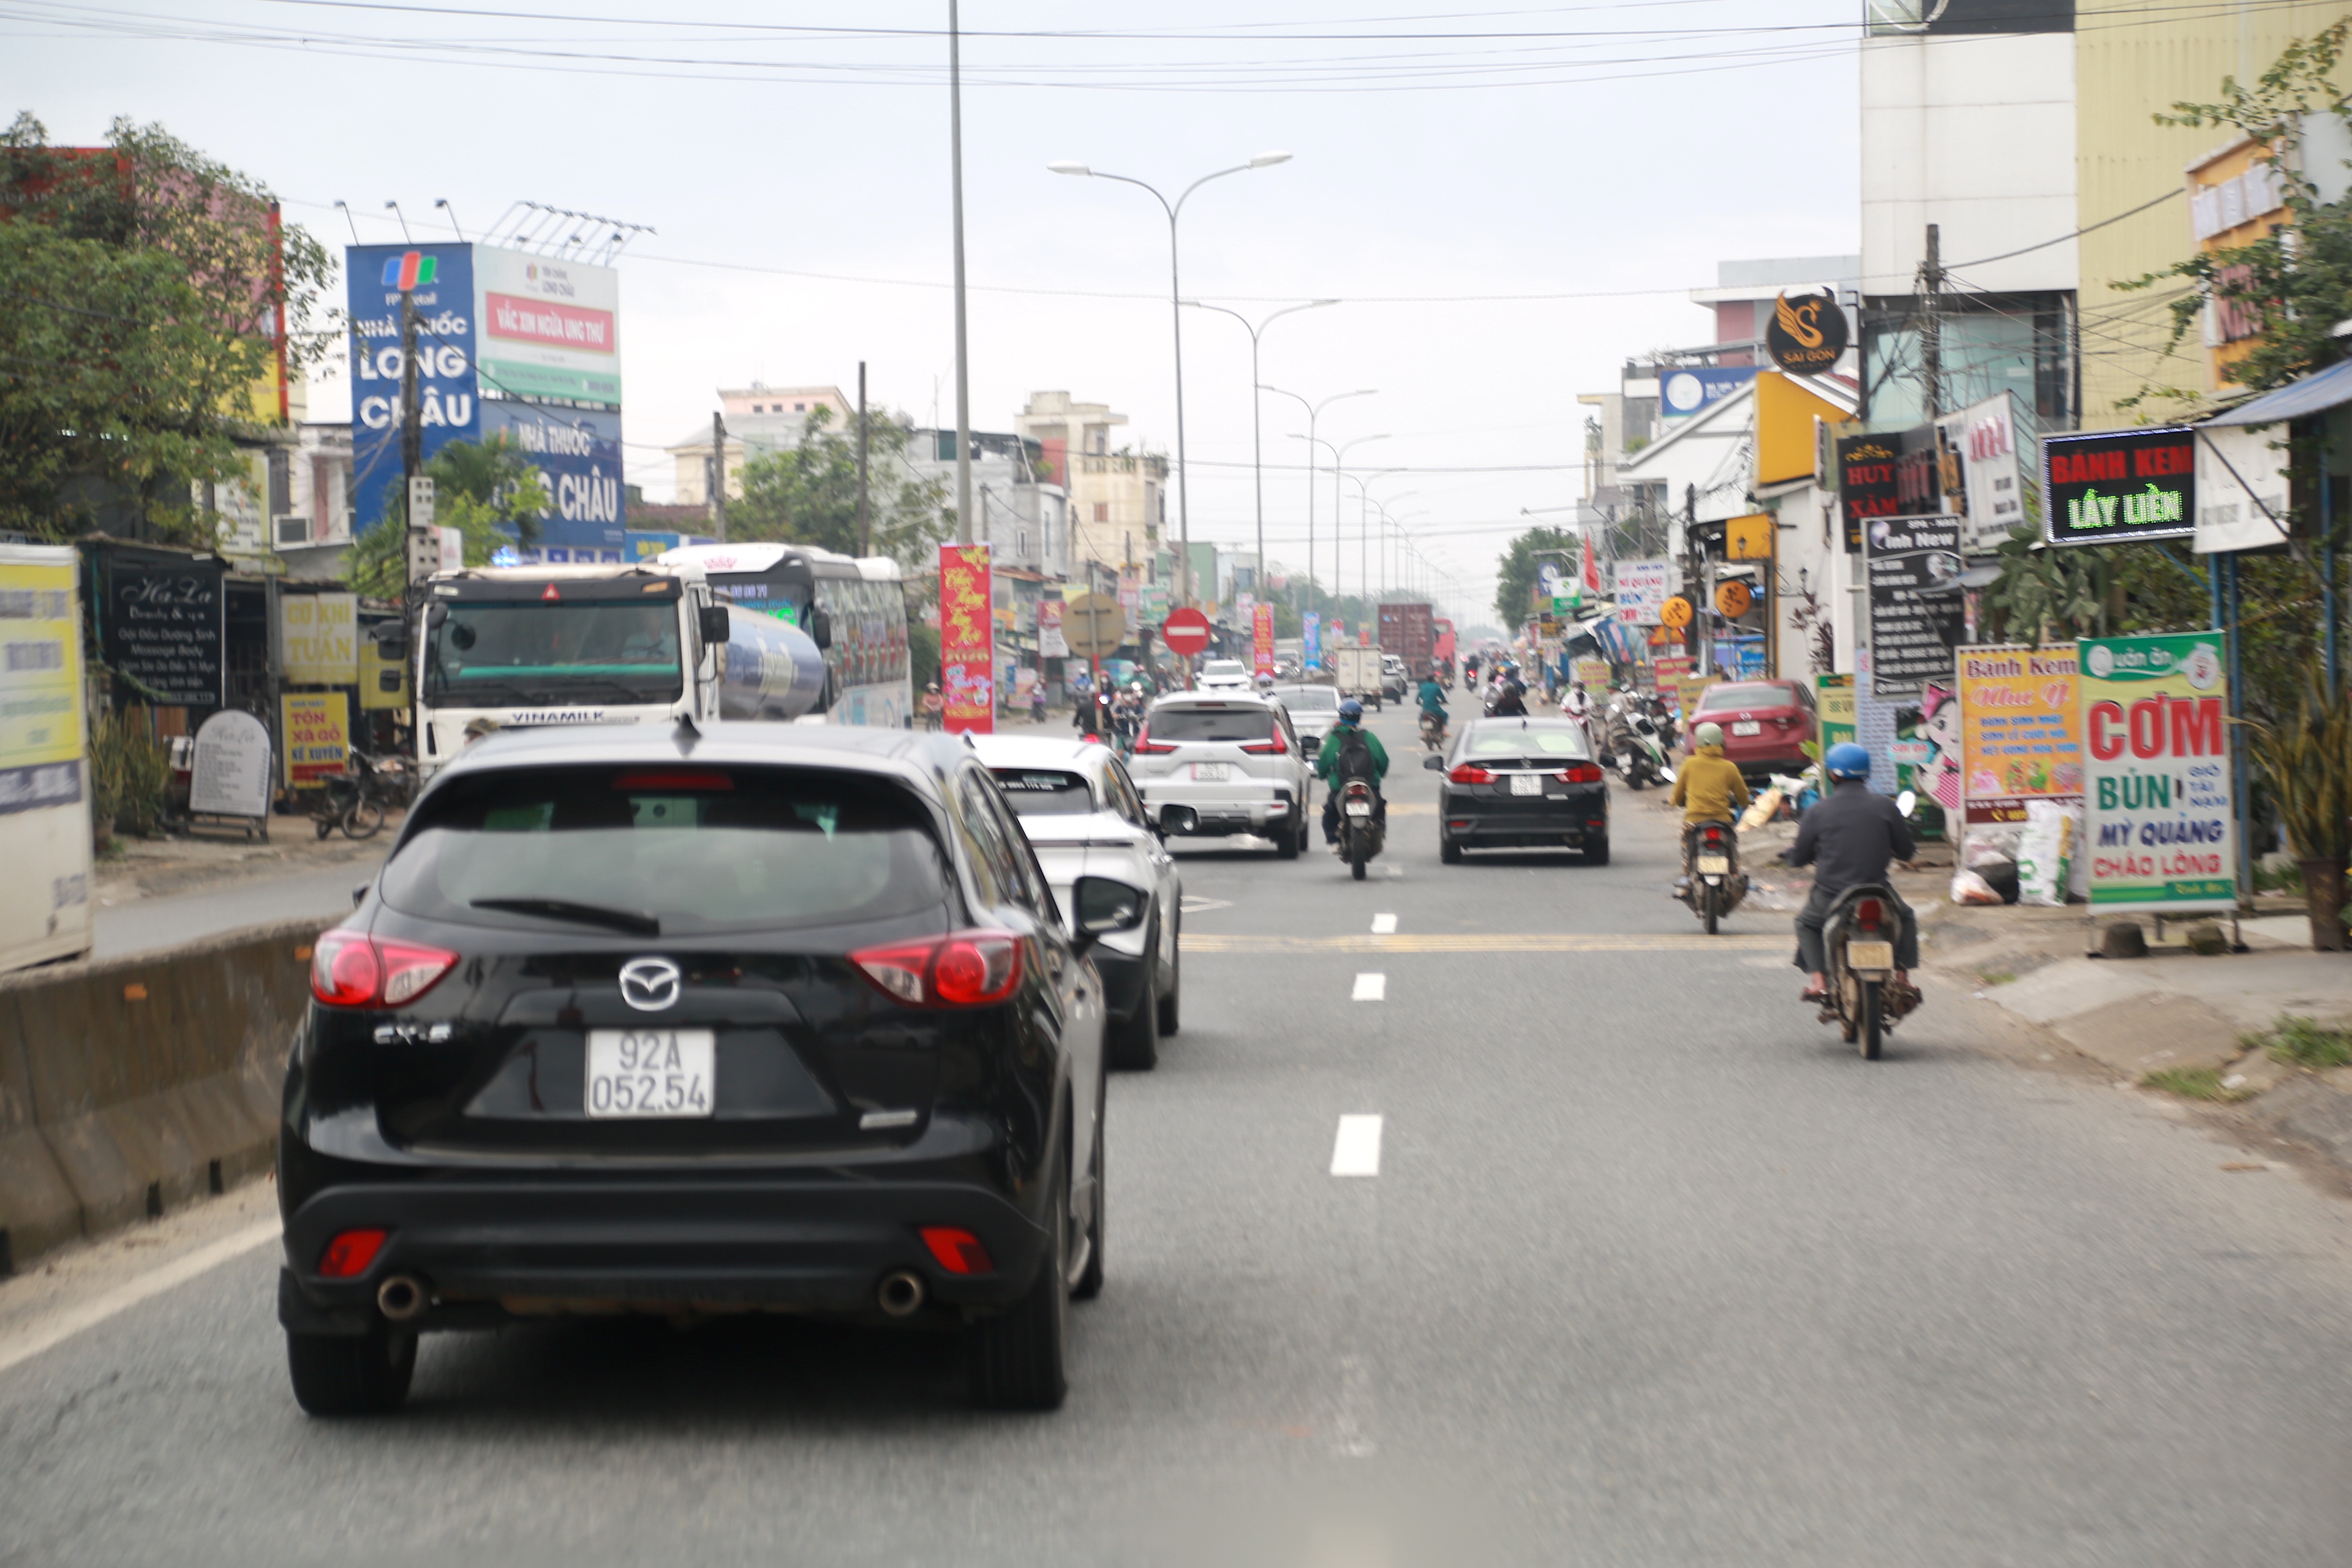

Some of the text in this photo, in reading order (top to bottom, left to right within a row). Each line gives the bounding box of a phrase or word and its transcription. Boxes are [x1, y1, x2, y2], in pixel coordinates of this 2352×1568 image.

[360, 345, 467, 380] LONG
[519, 417, 590, 457] NHÀ THUỐC
[1847, 464, 1894, 486] HUY
[2052, 445, 2194, 484] BÁNH KEM
[558, 464, 617, 522] CHÂU
[2068, 488, 2119, 529] LẤY
[2122, 483, 2183, 525] LIỀN
[1915, 531, 1956, 548] New
[287, 599, 352, 625] CƠ KHÍ
[130, 643, 203, 658] Massage Body
[195, 628, 216, 641] Sinh
[288, 626, 352, 662] TUẤN
[1966, 656, 2022, 679] Bánh
[2028, 655, 2079, 676] Kem
[291, 710, 326, 726] TÔN
[317, 722, 342, 743] GỒ
[512, 710, 604, 723] VINAMILK
[2088, 691, 2225, 761] CƠM
[307, 745, 344, 760] XUYÊN
[2097, 767, 2173, 811] BÚN
[2139, 811, 2226, 848] QUẢNG
[2093, 848, 2222, 879] CHÁO LÒNG
[619, 1031, 682, 1071] 92A
[592, 1073, 706, 1112] 052.54
